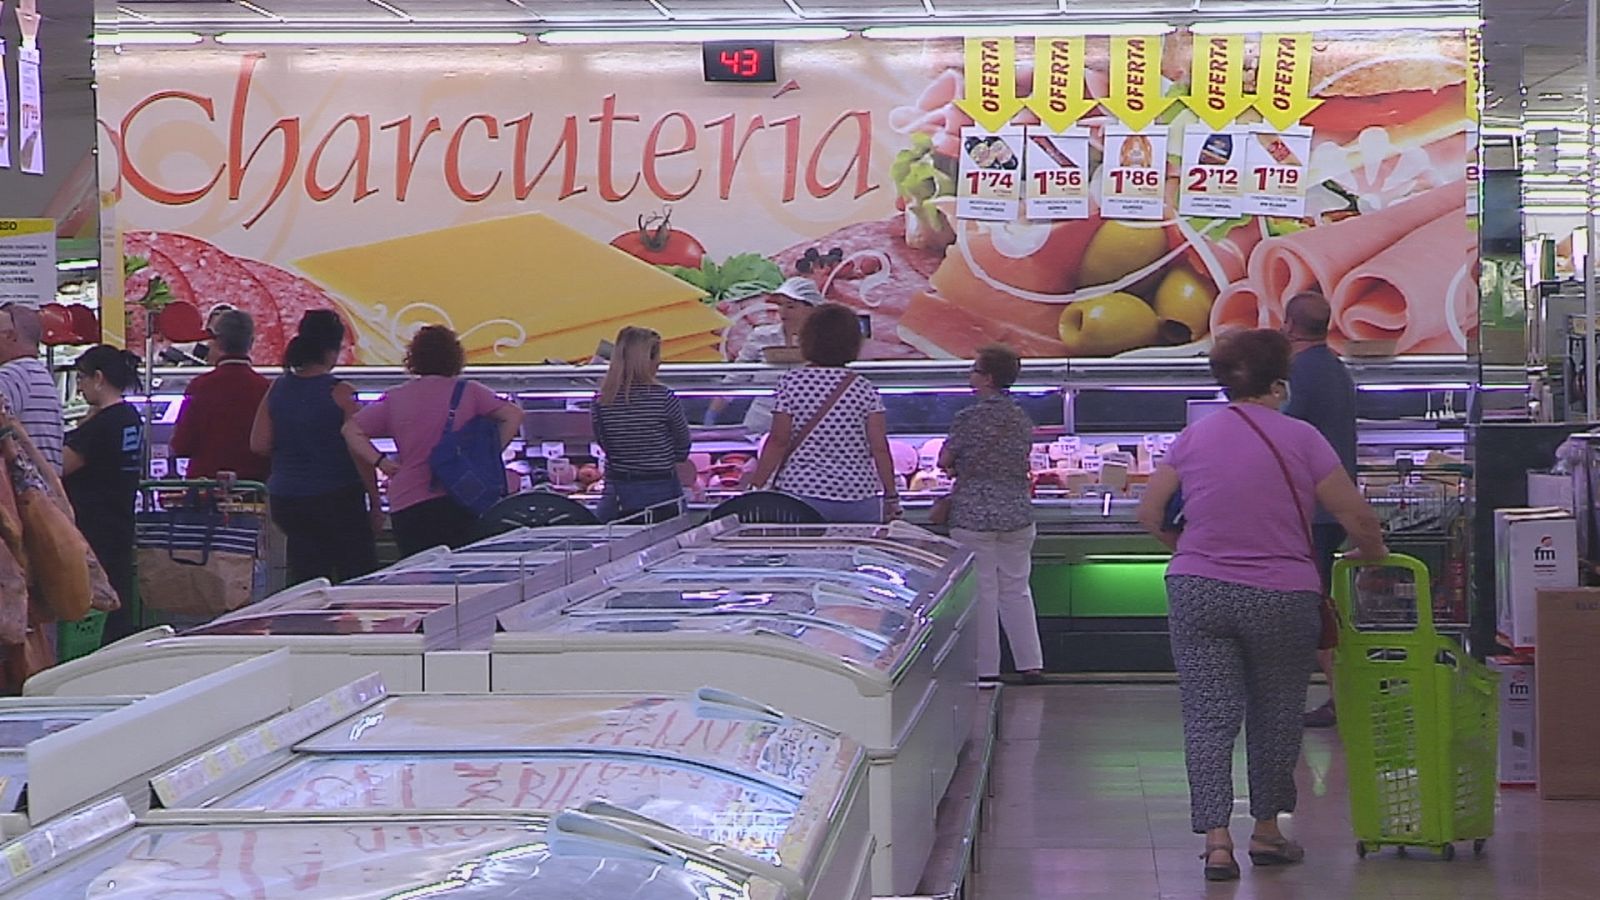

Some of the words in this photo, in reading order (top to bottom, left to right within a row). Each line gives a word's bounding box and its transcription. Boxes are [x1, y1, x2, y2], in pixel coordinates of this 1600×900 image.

[720, 48, 758, 76] 43
[1127, 38, 1145, 111] OFERTA
[1208, 37, 1228, 111] OFERTA
[1272, 37, 1295, 111] OFERTA
[982, 39, 1000, 112] OFERTA
[1050, 39, 1068, 112] OFERTA
[120, 52, 880, 230] Charcutería
[966, 171, 1013, 195] 1'74
[1034, 171, 1081, 195] 1'56
[1110, 170, 1158, 194] 1'86
[1187, 167, 1238, 192] 2'12
[1254, 167, 1298, 191] 1'19
[1534, 546, 1555, 560] fm
[1509, 682, 1529, 695] fm
